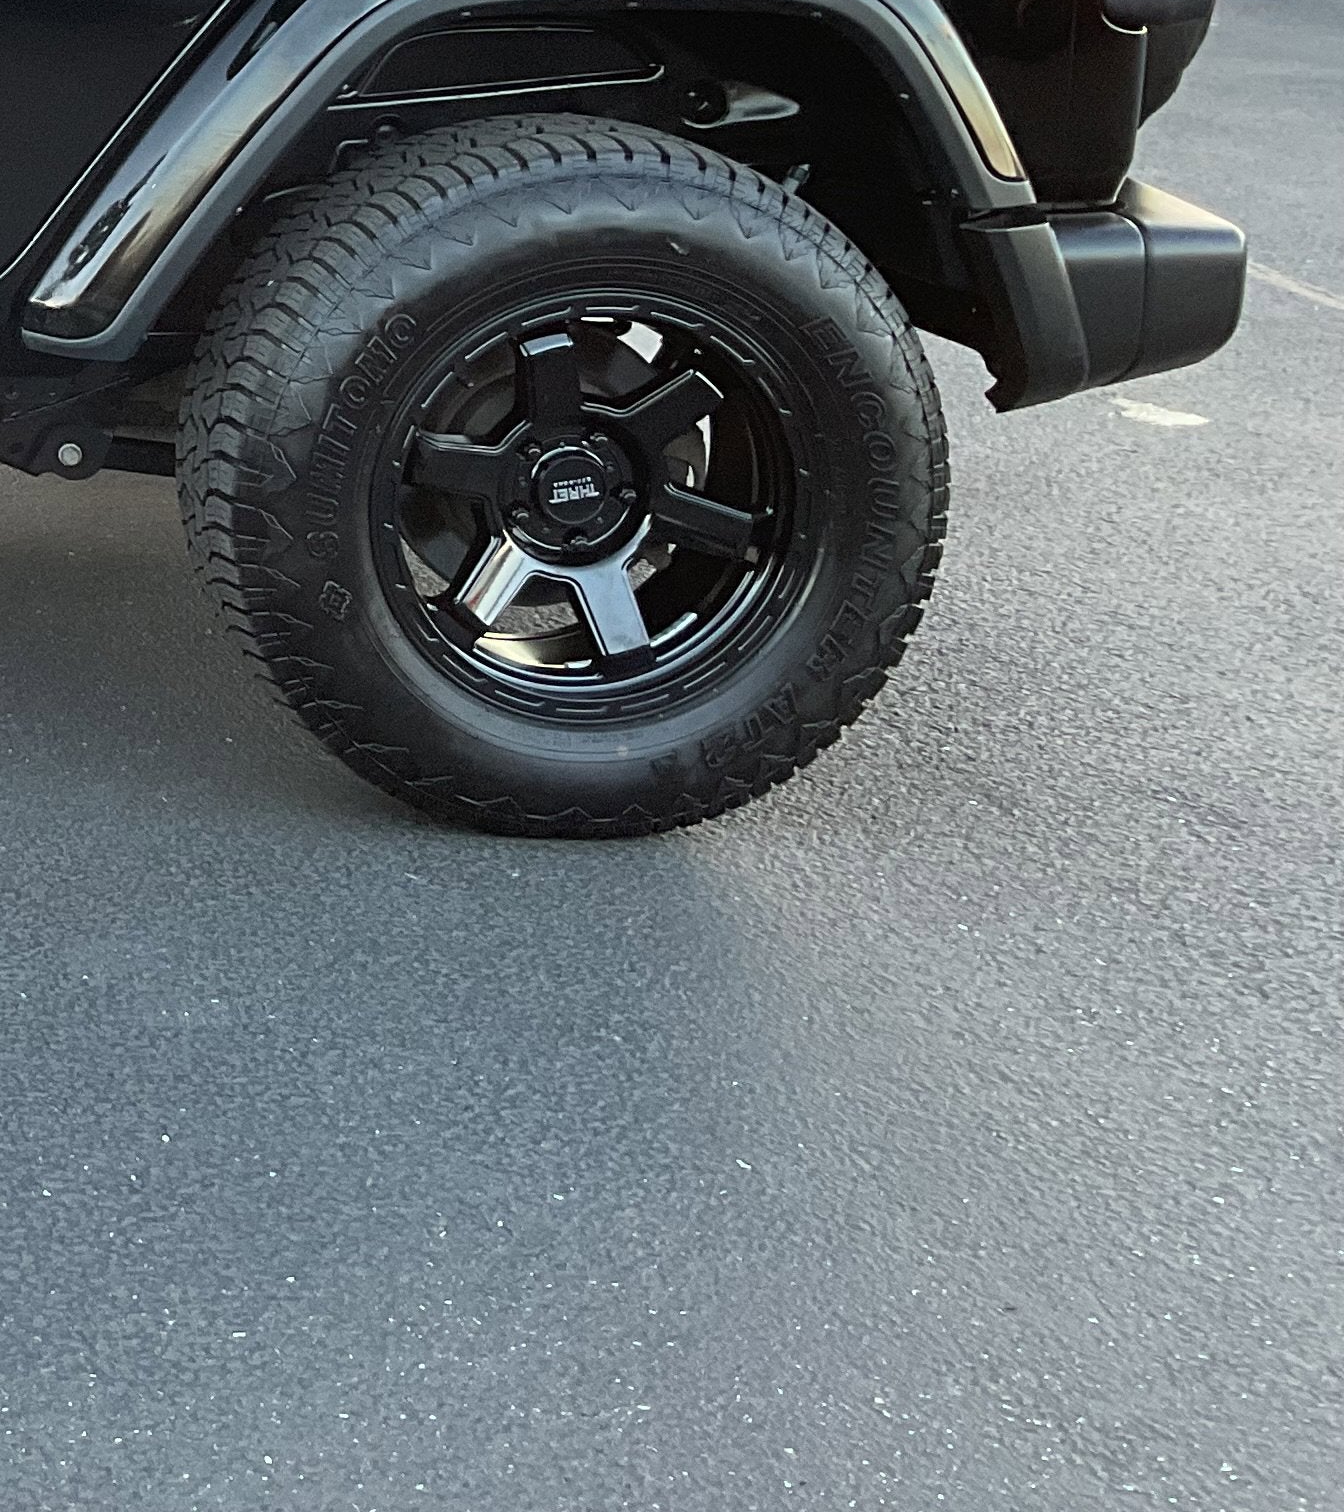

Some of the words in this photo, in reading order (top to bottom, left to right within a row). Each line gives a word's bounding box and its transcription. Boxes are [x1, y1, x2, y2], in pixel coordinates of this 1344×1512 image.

[306, 313, 416, 559] SUMITOMO
[548, 483, 600, 504] THRET
[802, 316, 901, 678] ENCOUNTER
